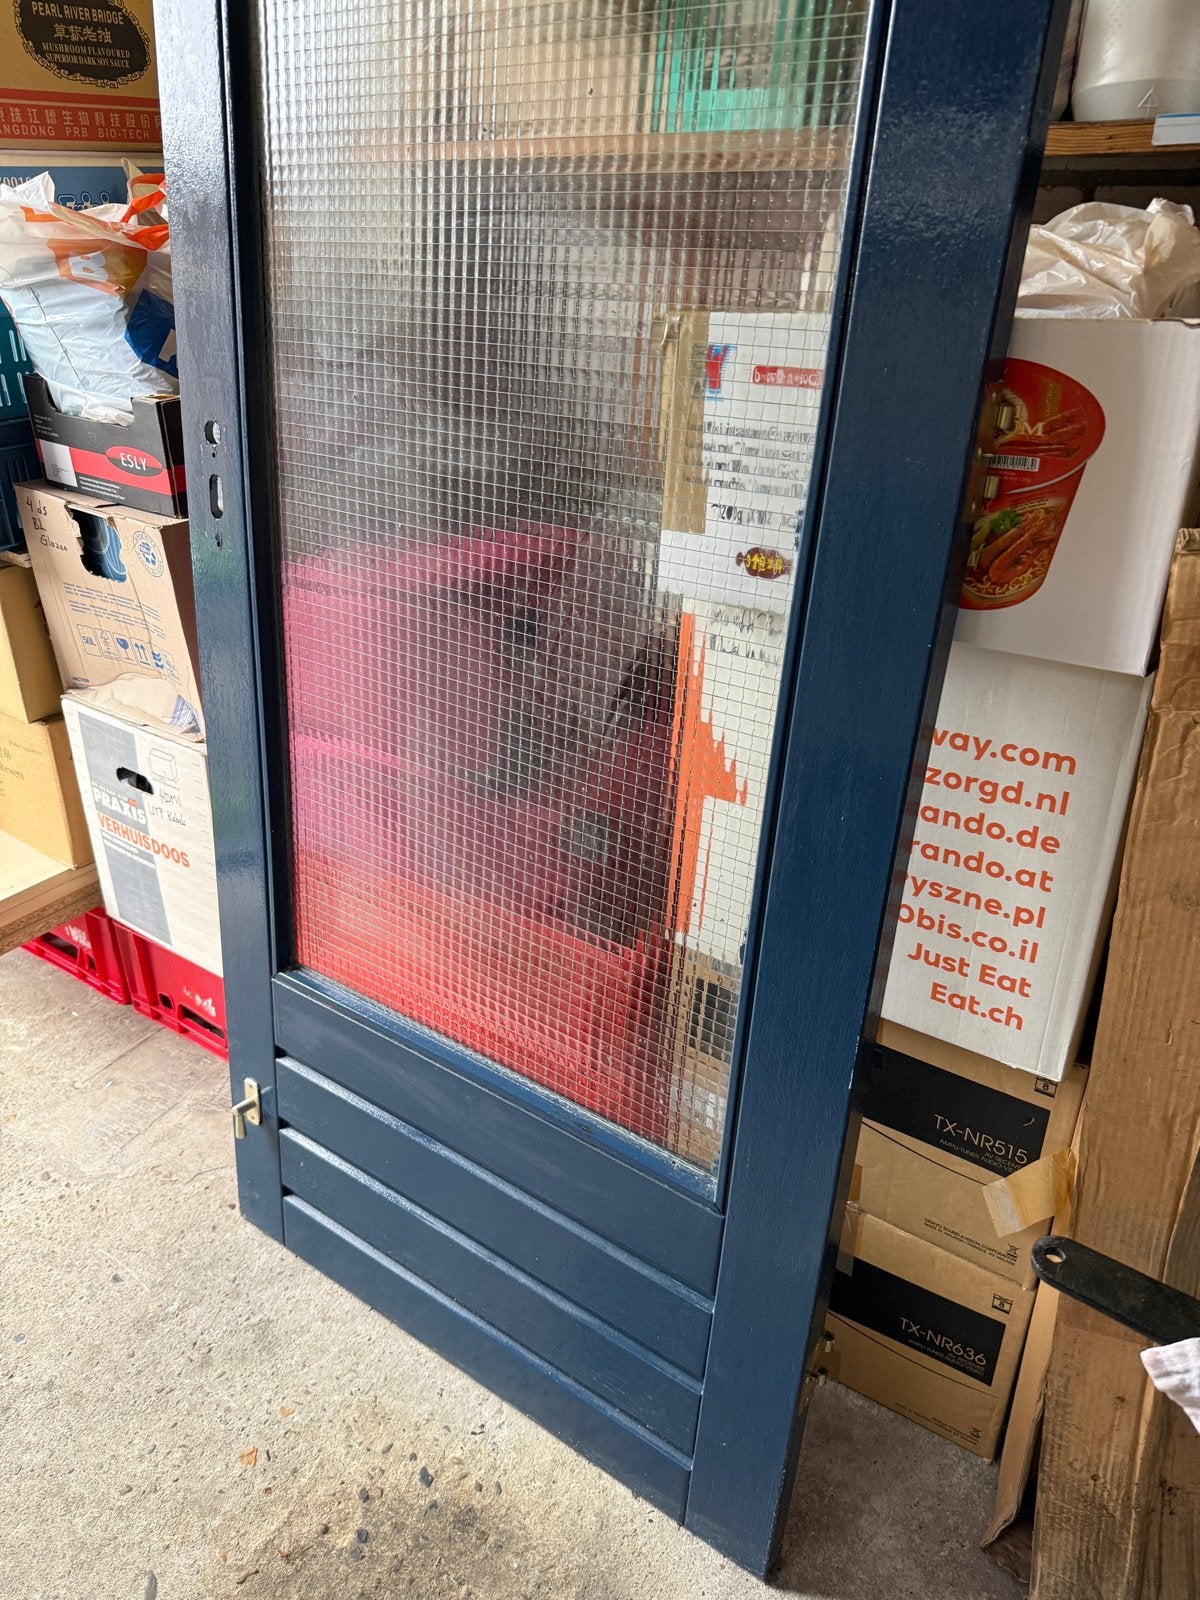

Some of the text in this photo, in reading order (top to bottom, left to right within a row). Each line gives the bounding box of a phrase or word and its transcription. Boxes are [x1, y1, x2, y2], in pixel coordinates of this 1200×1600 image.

[32, 1, 124, 25] PEARL RIVER BRIDGE
[42, 41, 130, 58] MUSHROOM FLAVOURED
[45, 52, 80, 64] SUPERIOR
[80, 54, 97, 65] DARK
[109, 58, 130, 68] SAUCE
[66, 127, 89, 137] PRB
[98, 129, 150, 139] BIO-TECH
[120, 452, 147, 471] ESLY
[93, 786, 147, 824] PRAXIS
[925, 766, 1070, 815] zorgd.nl
[97, 811, 190, 868] VERHUISDOOS
[920, 805, 1060, 854] ando.de
[905, 871, 1046, 929] yszne.pl
[908, 943, 1032, 999] Just Eat
[930, 981, 1024, 1032] Eat.ch
[934, 1114, 1028, 1164] TX-NR515
[900, 1317, 987, 1366] TX-NR636
